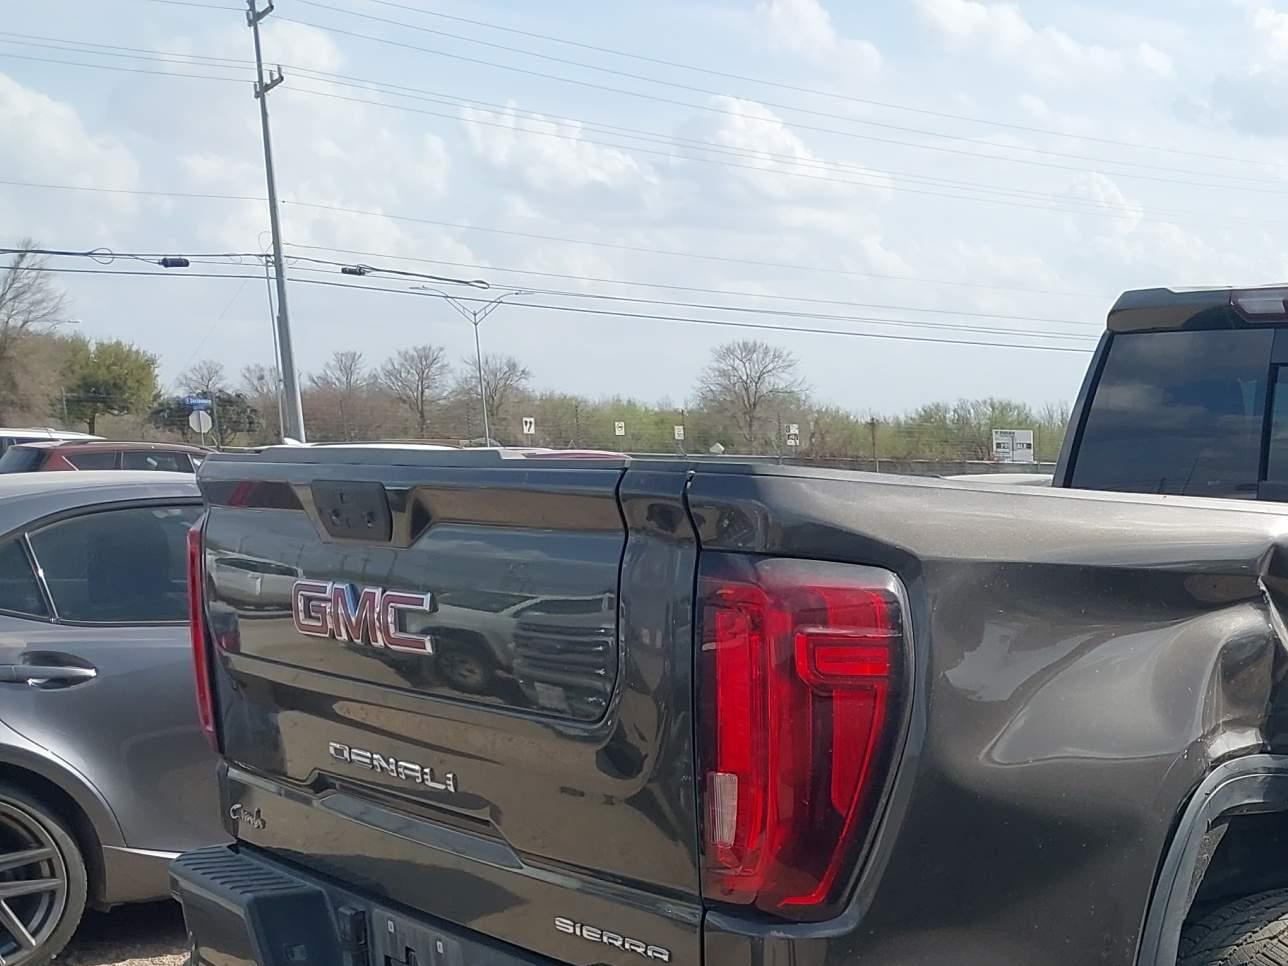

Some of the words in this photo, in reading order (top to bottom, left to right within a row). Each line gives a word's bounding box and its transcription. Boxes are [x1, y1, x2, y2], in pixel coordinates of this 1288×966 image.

[292, 580, 435, 656] GMC
[329, 740, 458, 793] DENALI
[554, 916, 671, 963] SIERRA
